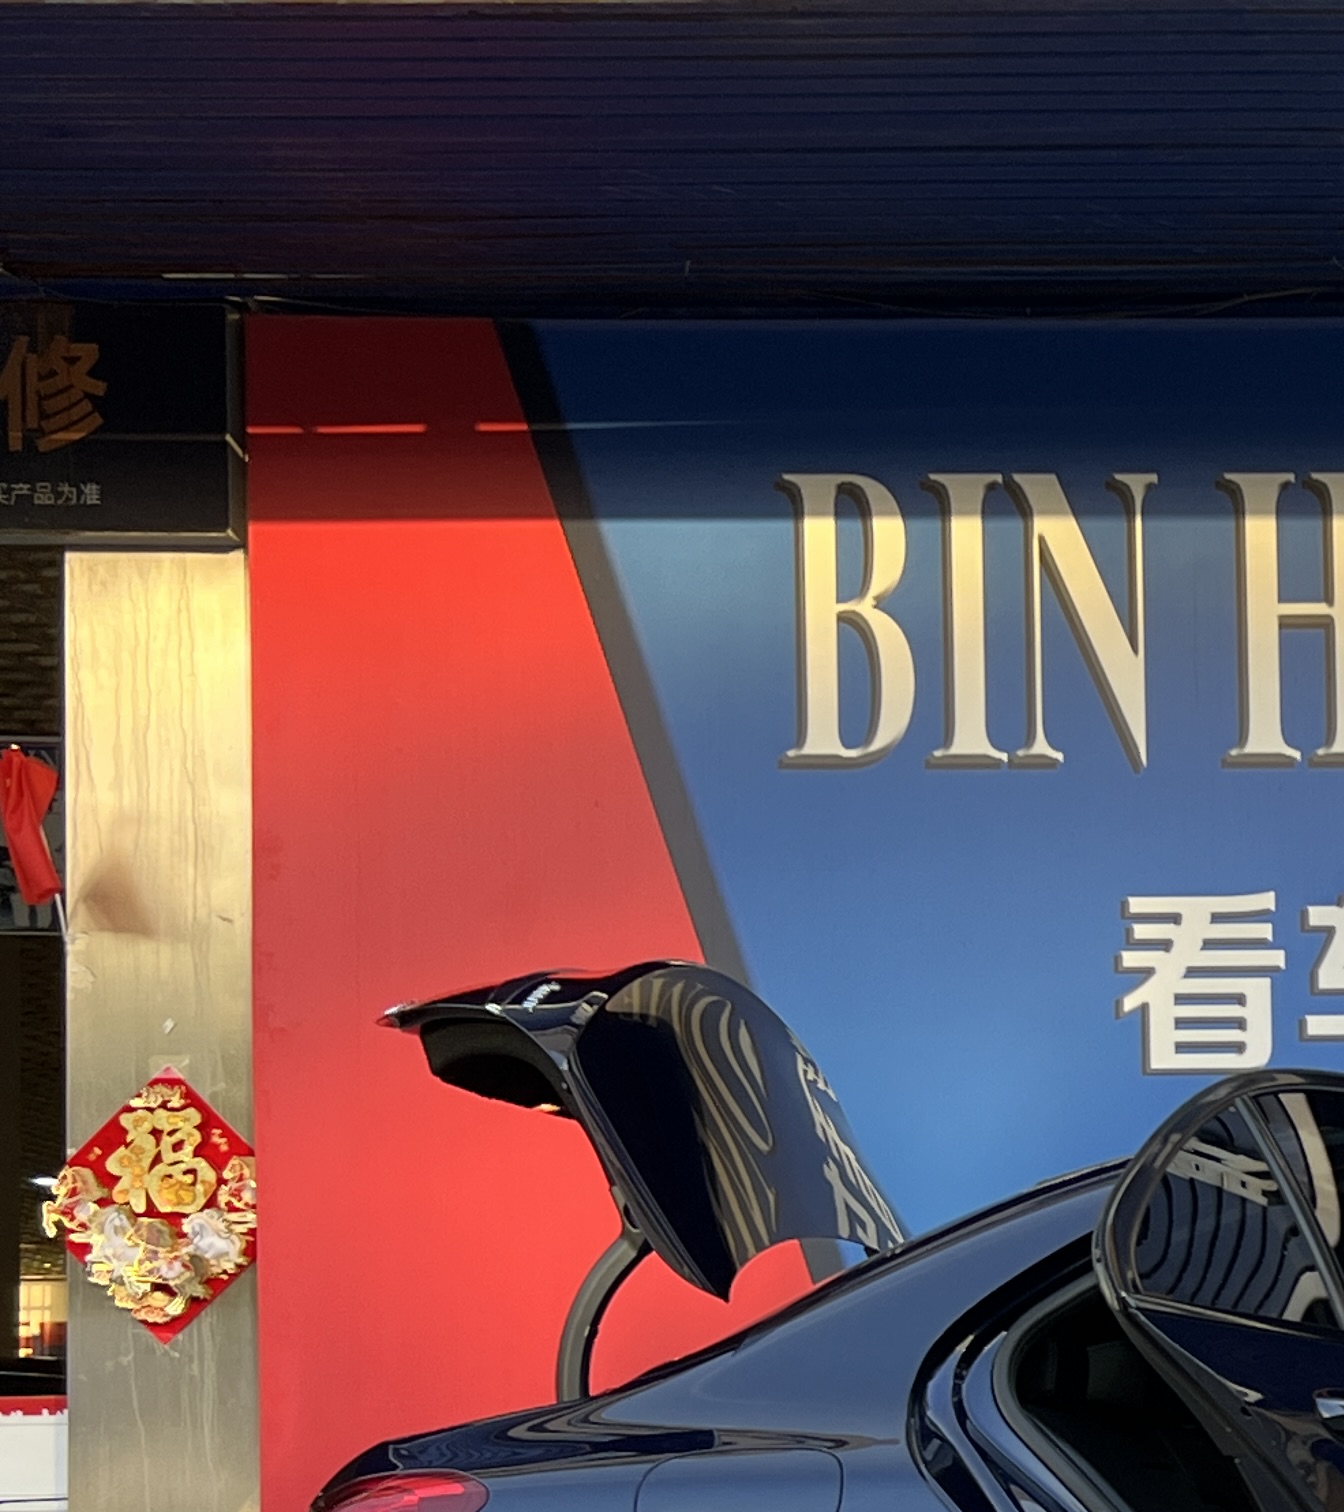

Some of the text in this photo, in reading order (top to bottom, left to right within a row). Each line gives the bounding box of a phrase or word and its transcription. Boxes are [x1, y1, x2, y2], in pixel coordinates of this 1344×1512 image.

[0, 335, 108, 452] 修
[775, 470, 1159, 773] BIN
[105, 1106, 218, 1214] 福
